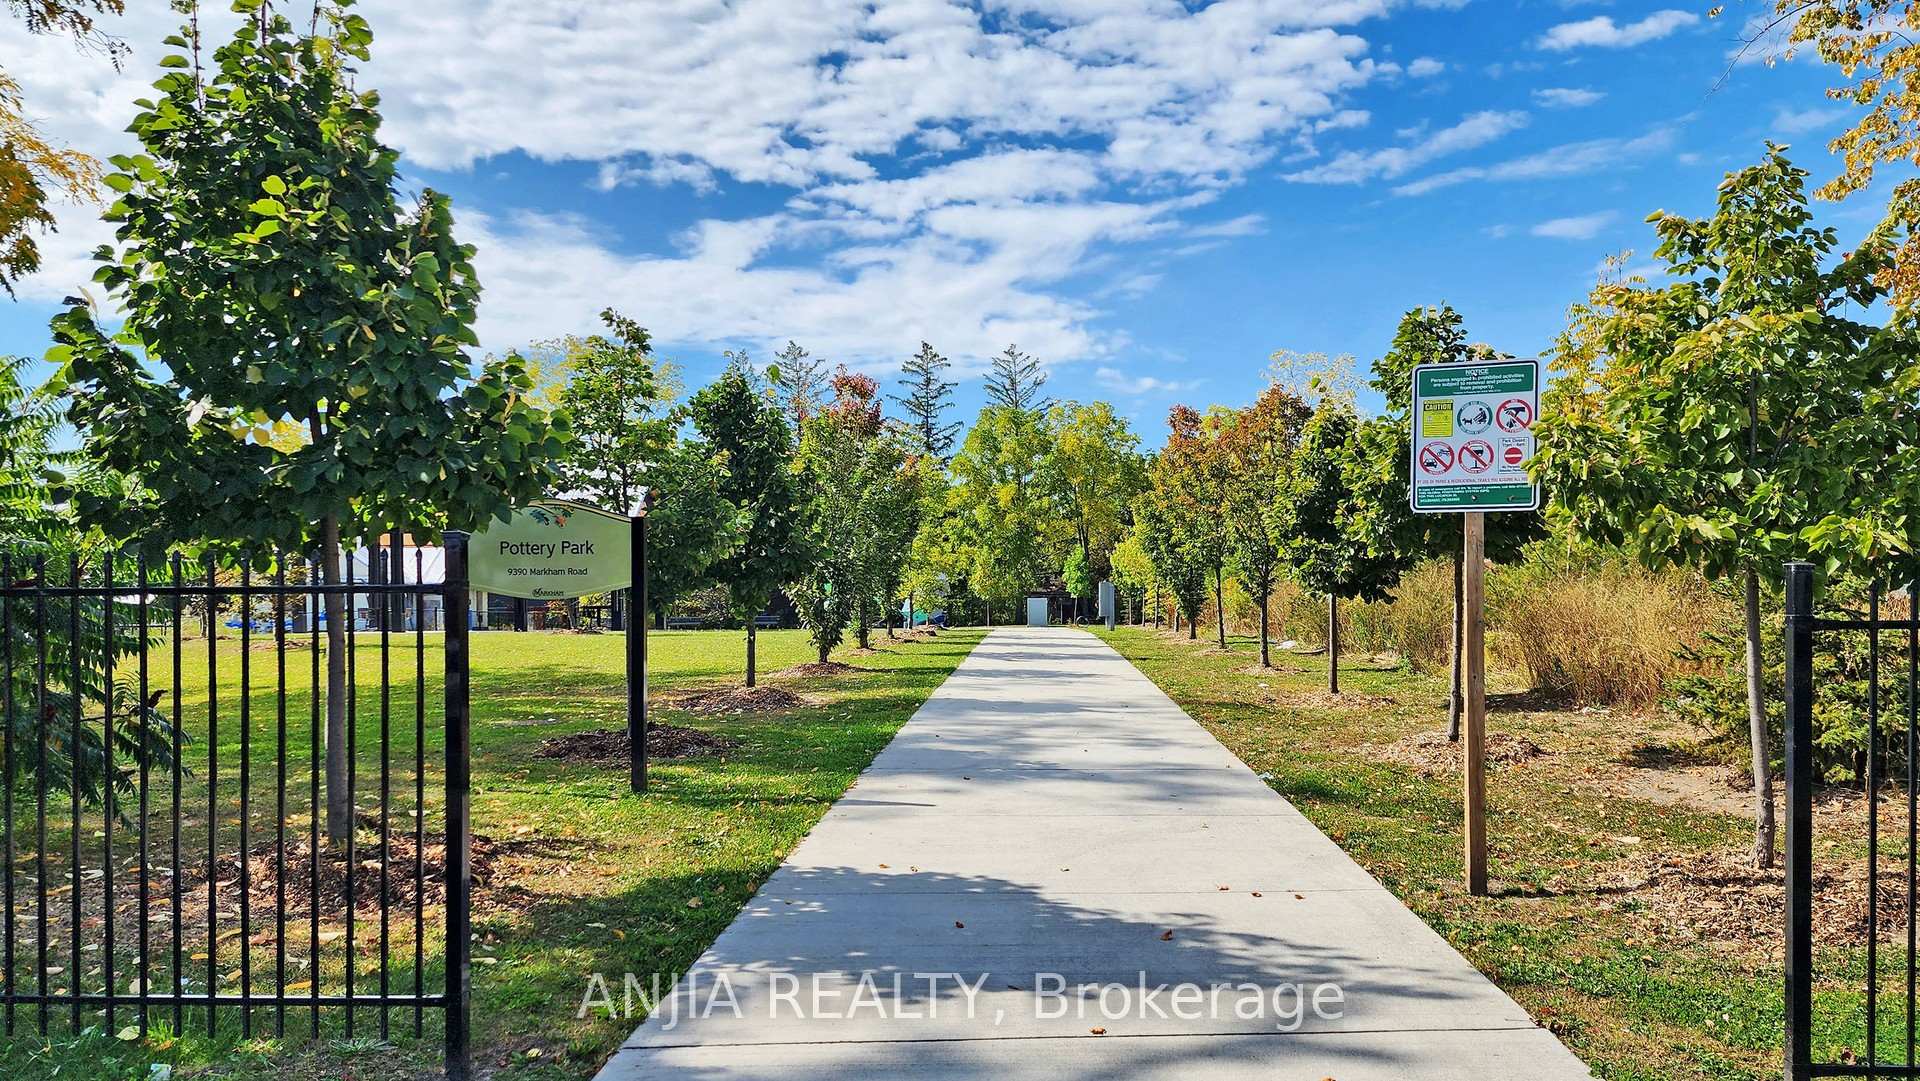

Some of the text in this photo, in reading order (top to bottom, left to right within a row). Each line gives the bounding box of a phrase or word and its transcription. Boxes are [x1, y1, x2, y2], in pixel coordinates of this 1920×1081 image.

[1465, 368, 1489, 376] NOTICE
[500, 540, 594, 558] Pottery Park
